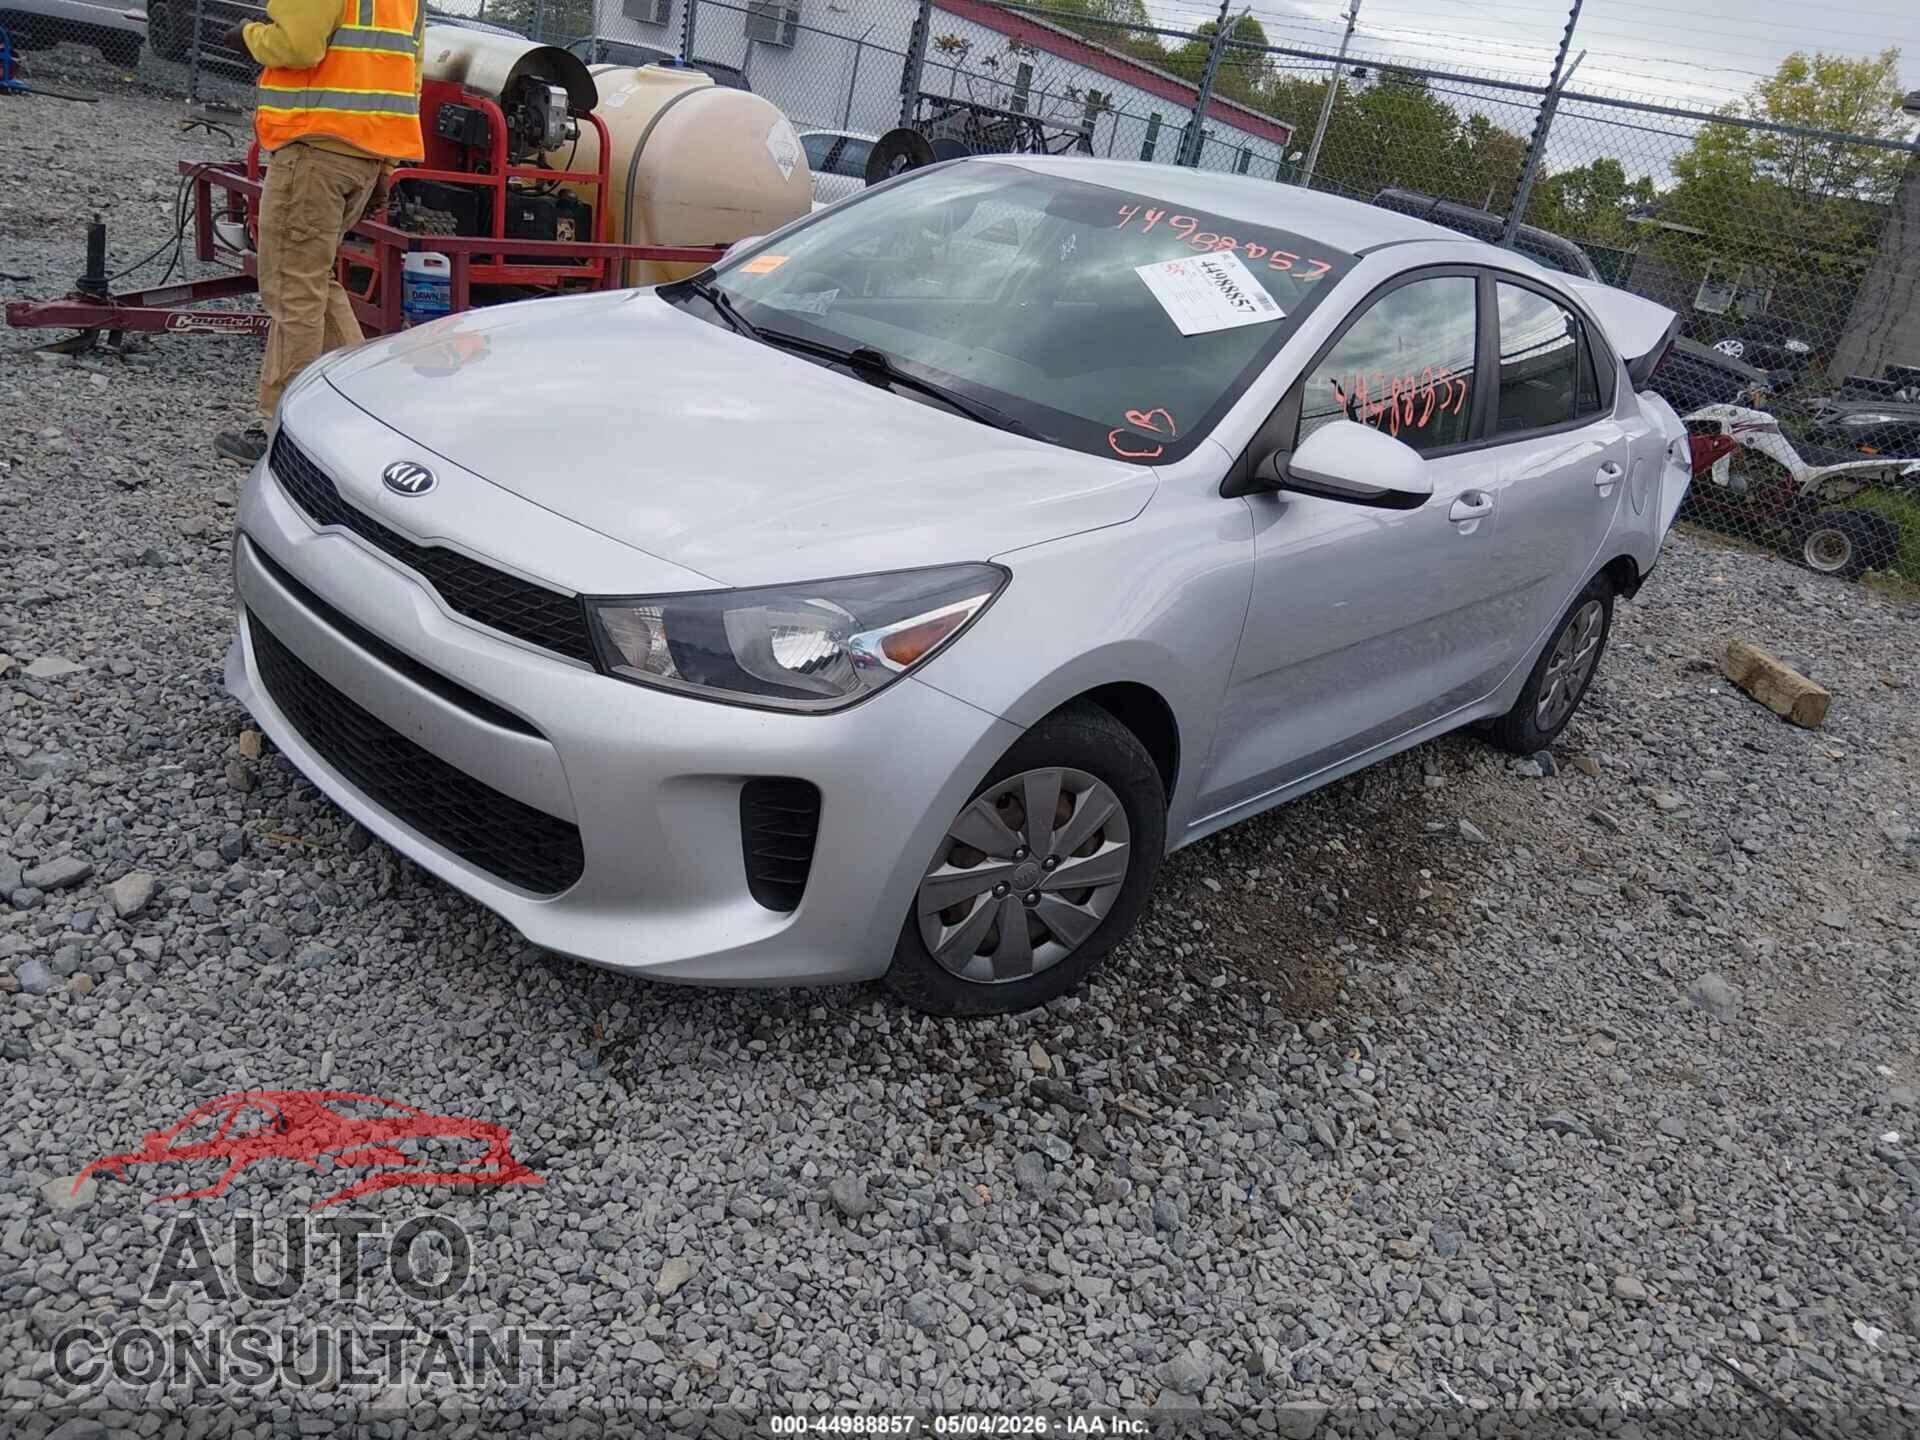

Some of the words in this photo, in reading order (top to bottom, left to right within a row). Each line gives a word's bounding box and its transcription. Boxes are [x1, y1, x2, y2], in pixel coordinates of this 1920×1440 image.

[412, 290, 440, 301] DAWN
[1200, 259, 1257, 313] 44988857
[385, 462, 427, 491] KIA
